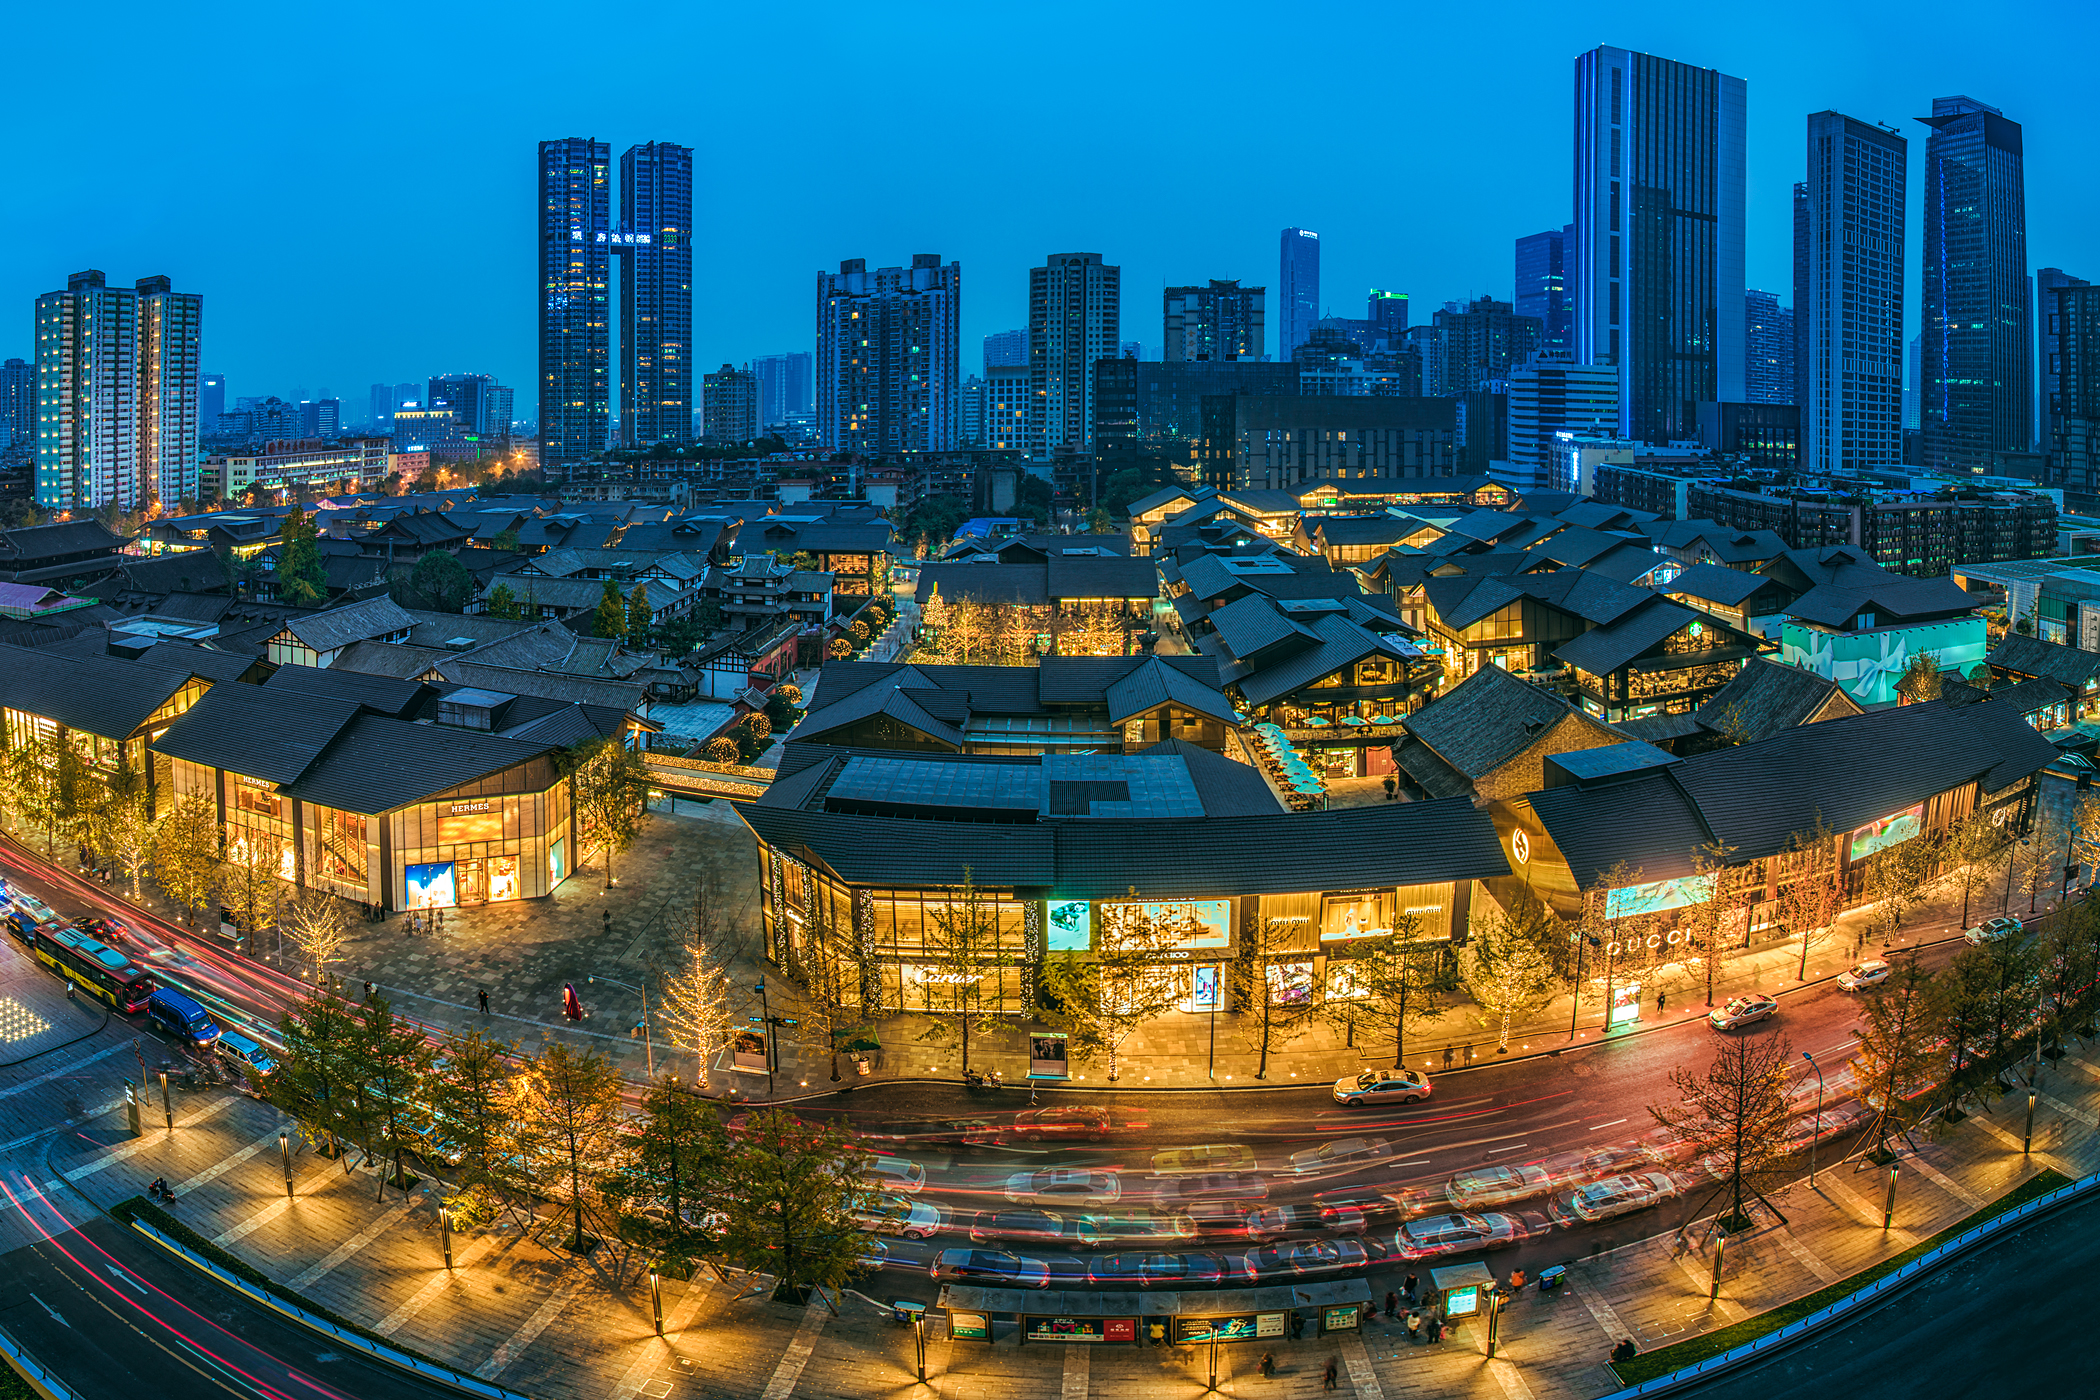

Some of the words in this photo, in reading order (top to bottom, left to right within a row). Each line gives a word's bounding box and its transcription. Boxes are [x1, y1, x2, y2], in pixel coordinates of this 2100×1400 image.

[243, 776, 270, 788] HERMES
[451, 803, 490, 812] HERMES
[1606, 928, 1691, 956] GUCCI
[915, 967, 984, 984] Cartier
